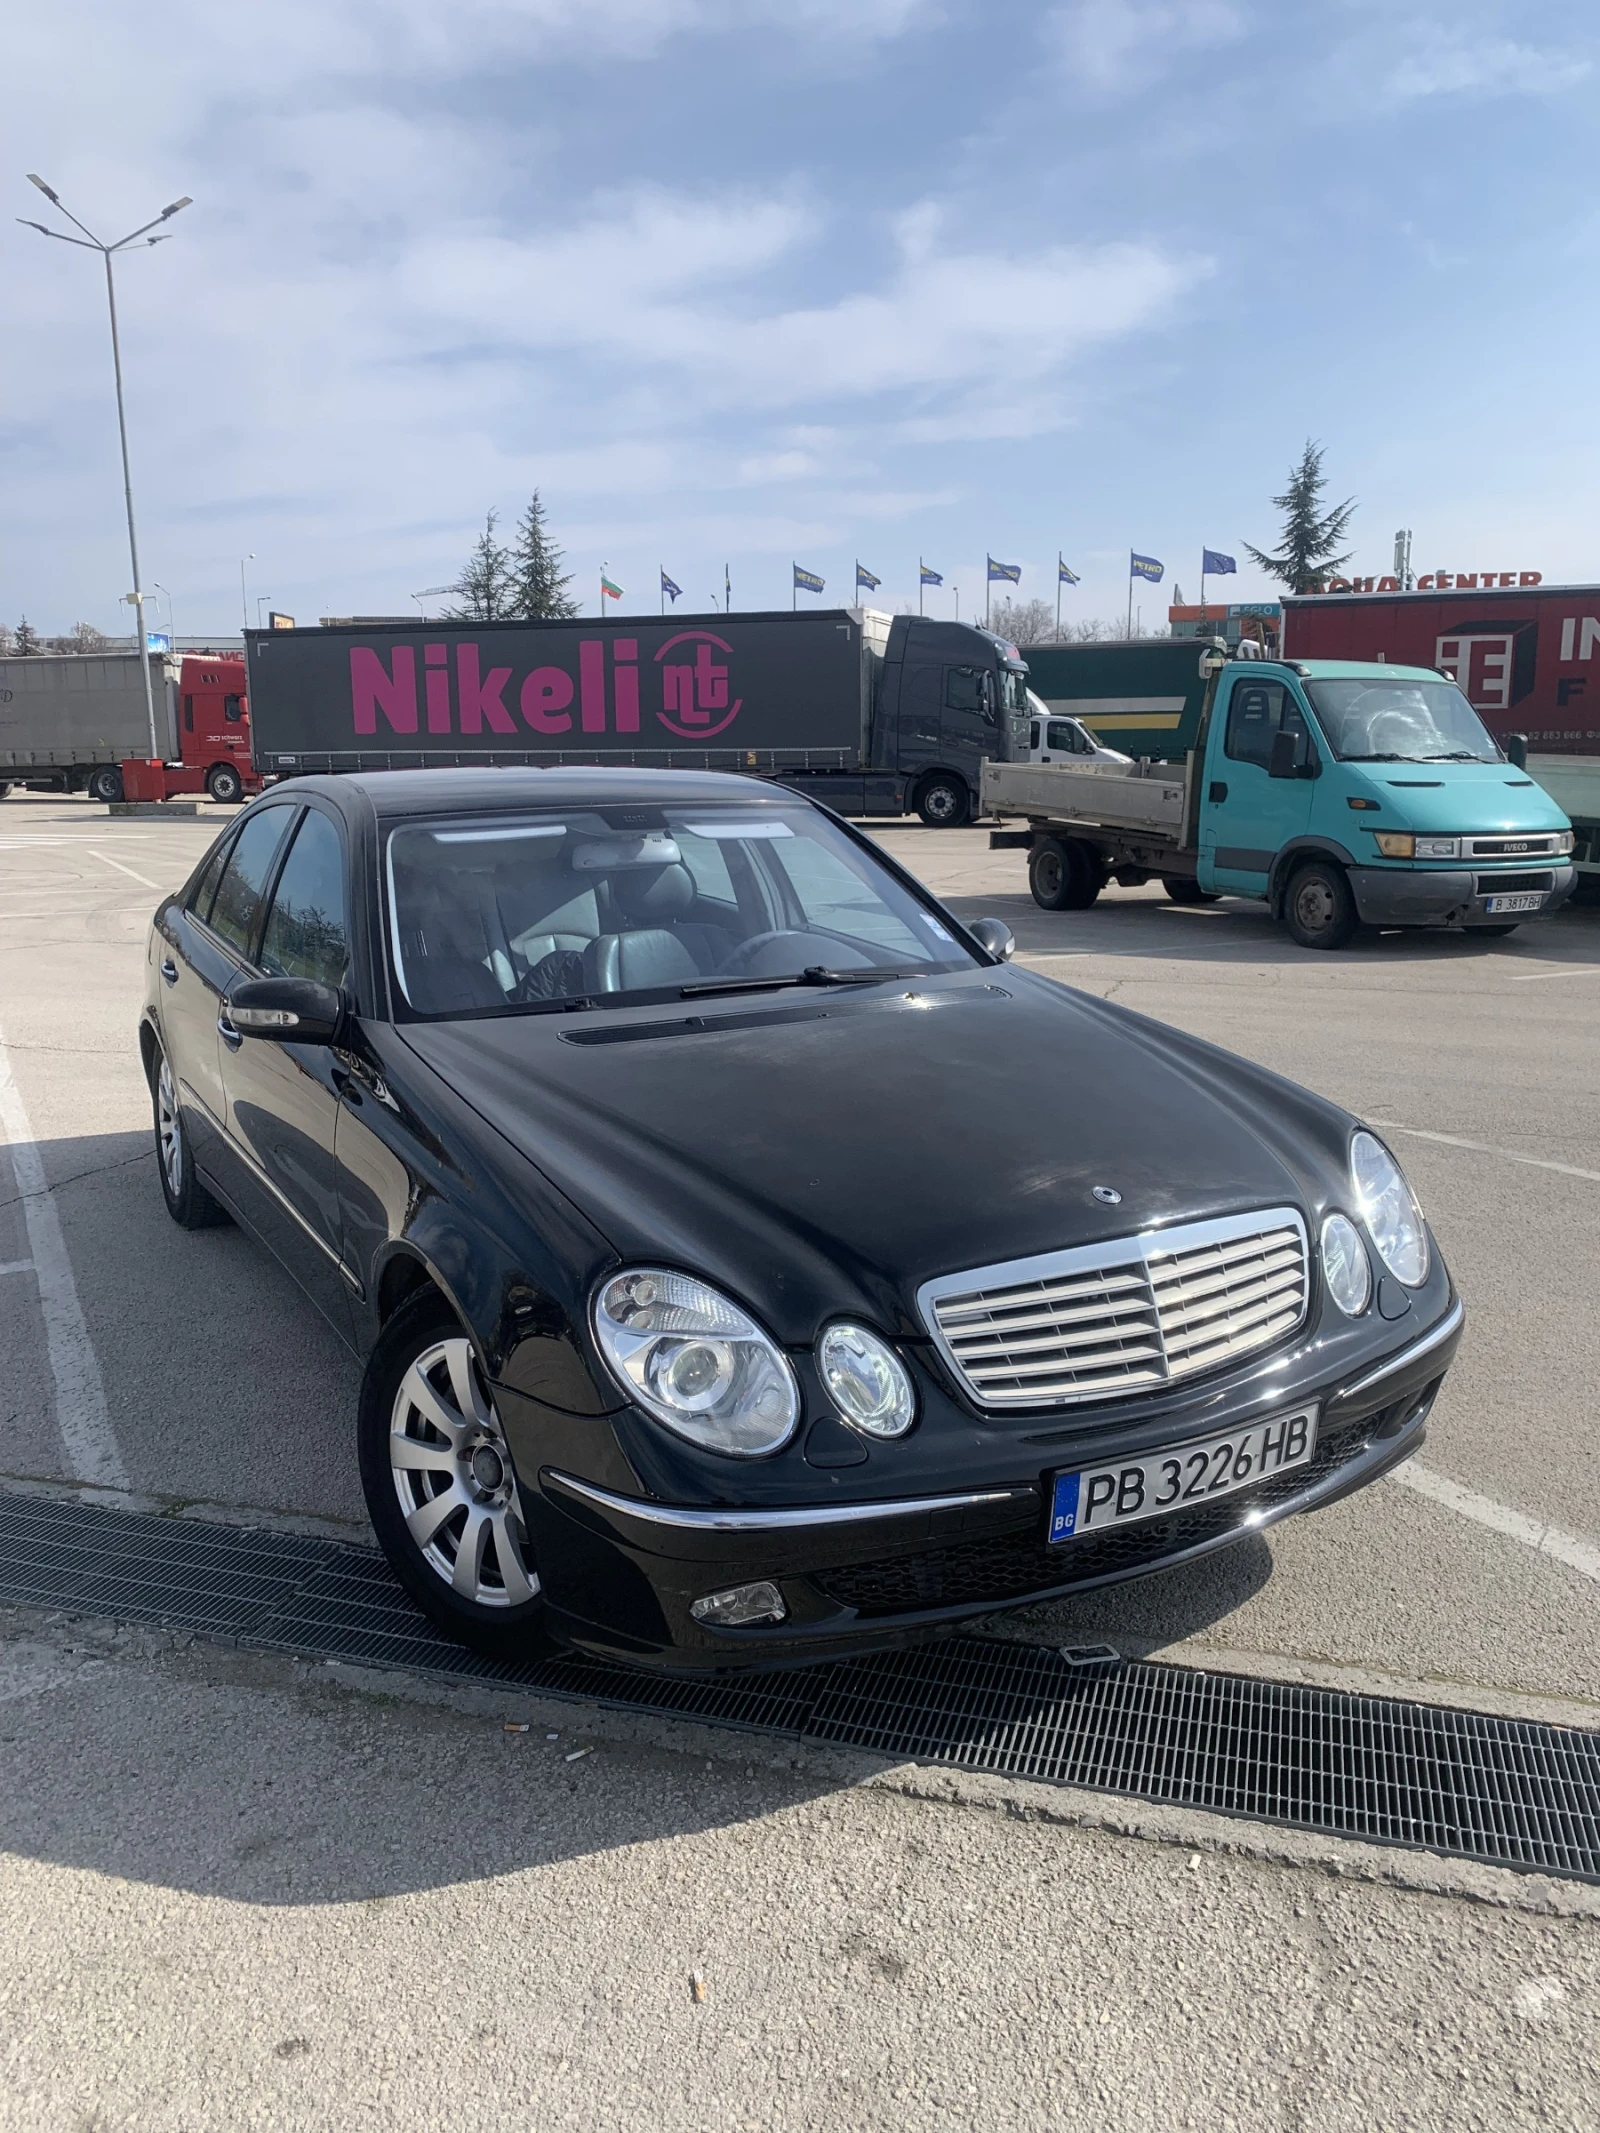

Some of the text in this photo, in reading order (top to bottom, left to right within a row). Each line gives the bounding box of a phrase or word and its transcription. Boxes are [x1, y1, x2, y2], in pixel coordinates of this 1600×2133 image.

[1417, 571, 1543, 590] CENTER
[349, 638, 640, 734] Nikeli
[1503, 843, 1528, 852] IVECO
[1495, 899, 1503, 911] B
[1506, 898, 1528, 910] 3817
[1083, 1414, 1309, 1524] PB 3226 HB
[1055, 1514, 1075, 1531] BG
